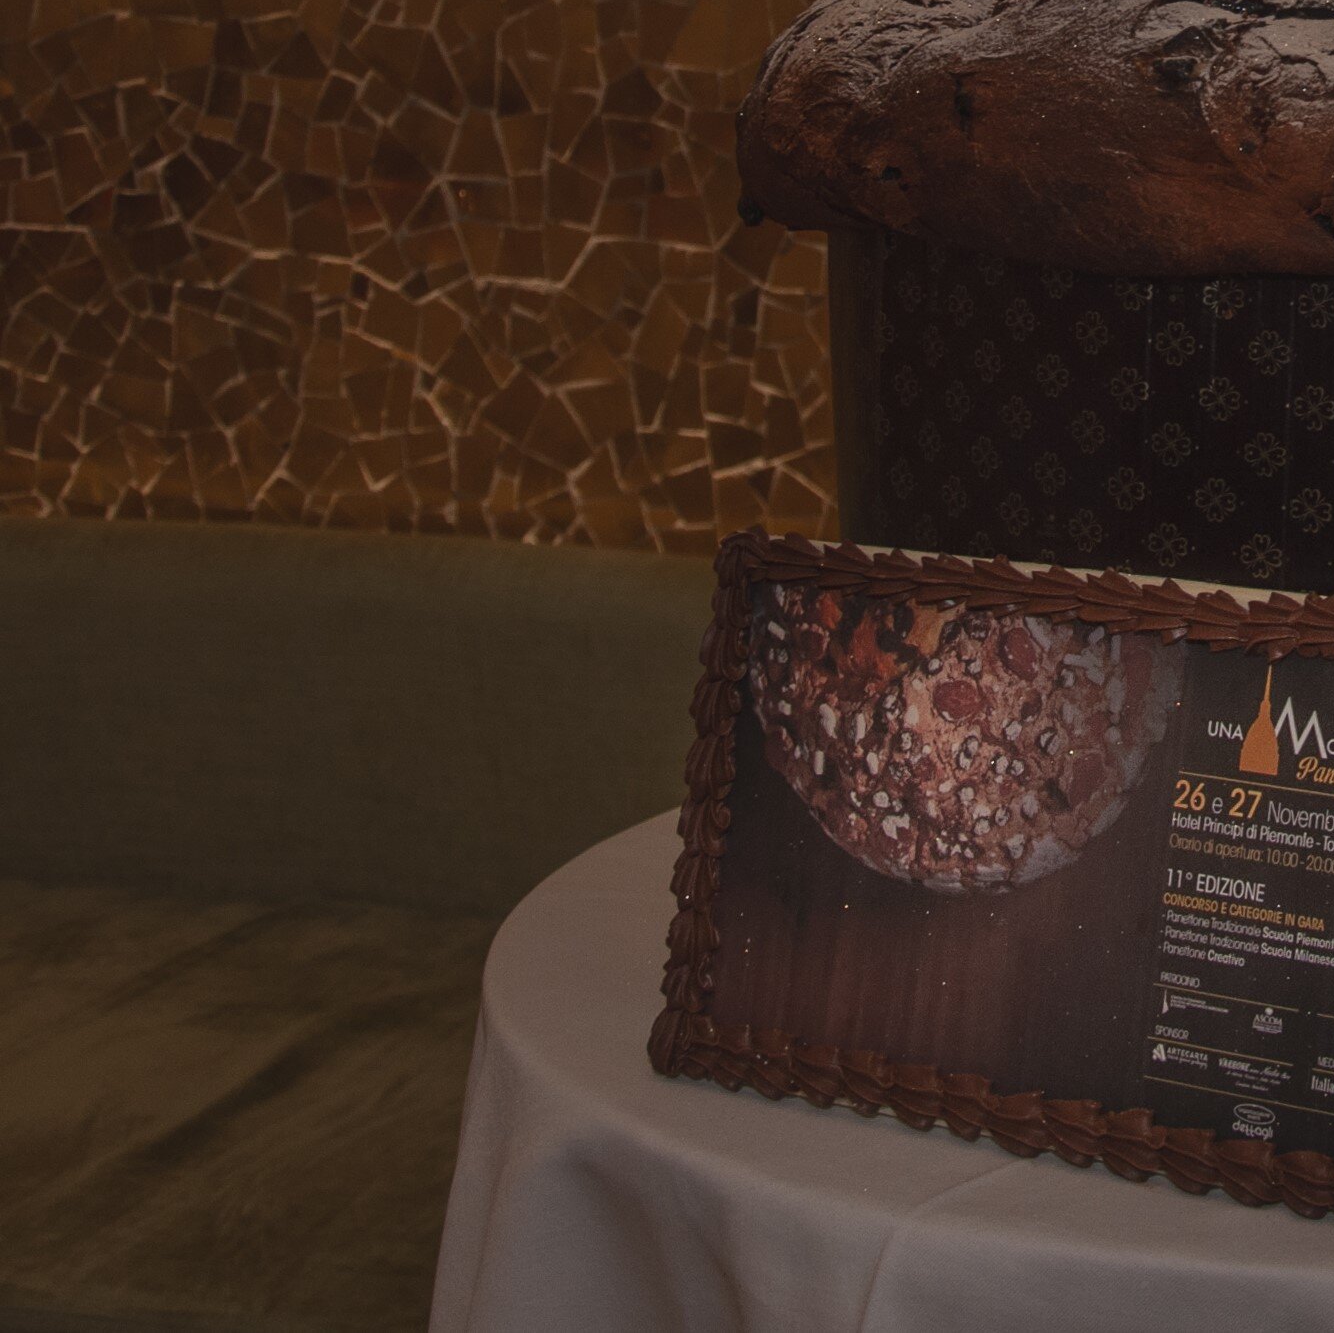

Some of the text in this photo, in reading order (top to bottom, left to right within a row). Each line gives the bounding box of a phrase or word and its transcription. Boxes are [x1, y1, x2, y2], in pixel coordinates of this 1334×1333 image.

[1208, 720, 1244, 741] UNA
[1173, 779, 1206, 811] 26
[1211, 797, 1224, 814] e
[1228, 787, 1262, 819] 27
[1171, 811, 1201, 830] Hotel
[1202, 816, 1245, 840] Principi
[1246, 823, 1258, 840] di
[1259, 825, 1314, 849] Piemonte
[1169, 832, 1202, 852] Orario
[1203, 838, 1214, 854] di
[1215, 843, 1264, 862] apertura:
[1196, 873, 1266, 903] EDIZIONE
[1163, 891, 1325, 932] CONCORSO E CATEGORIE IN GARA
[1166, 909, 1210, 928] Panettone
[1210, 916, 1261, 937] Tradizionale
[1262, 926, 1294, 943] Scuola
[1162, 940, 1245, 967] Panettone Creativo
[1164, 925, 1208, 944] Panettone
[1209, 933, 1260, 953] Tradizionale
[1260, 942, 1292, 959] Scuola
[1155, 1024, 1189, 1040] SPONSOR
[1167, 1046, 1208, 1061] ARTECARTA
[1310, 1075, 1334, 1094] Italia
